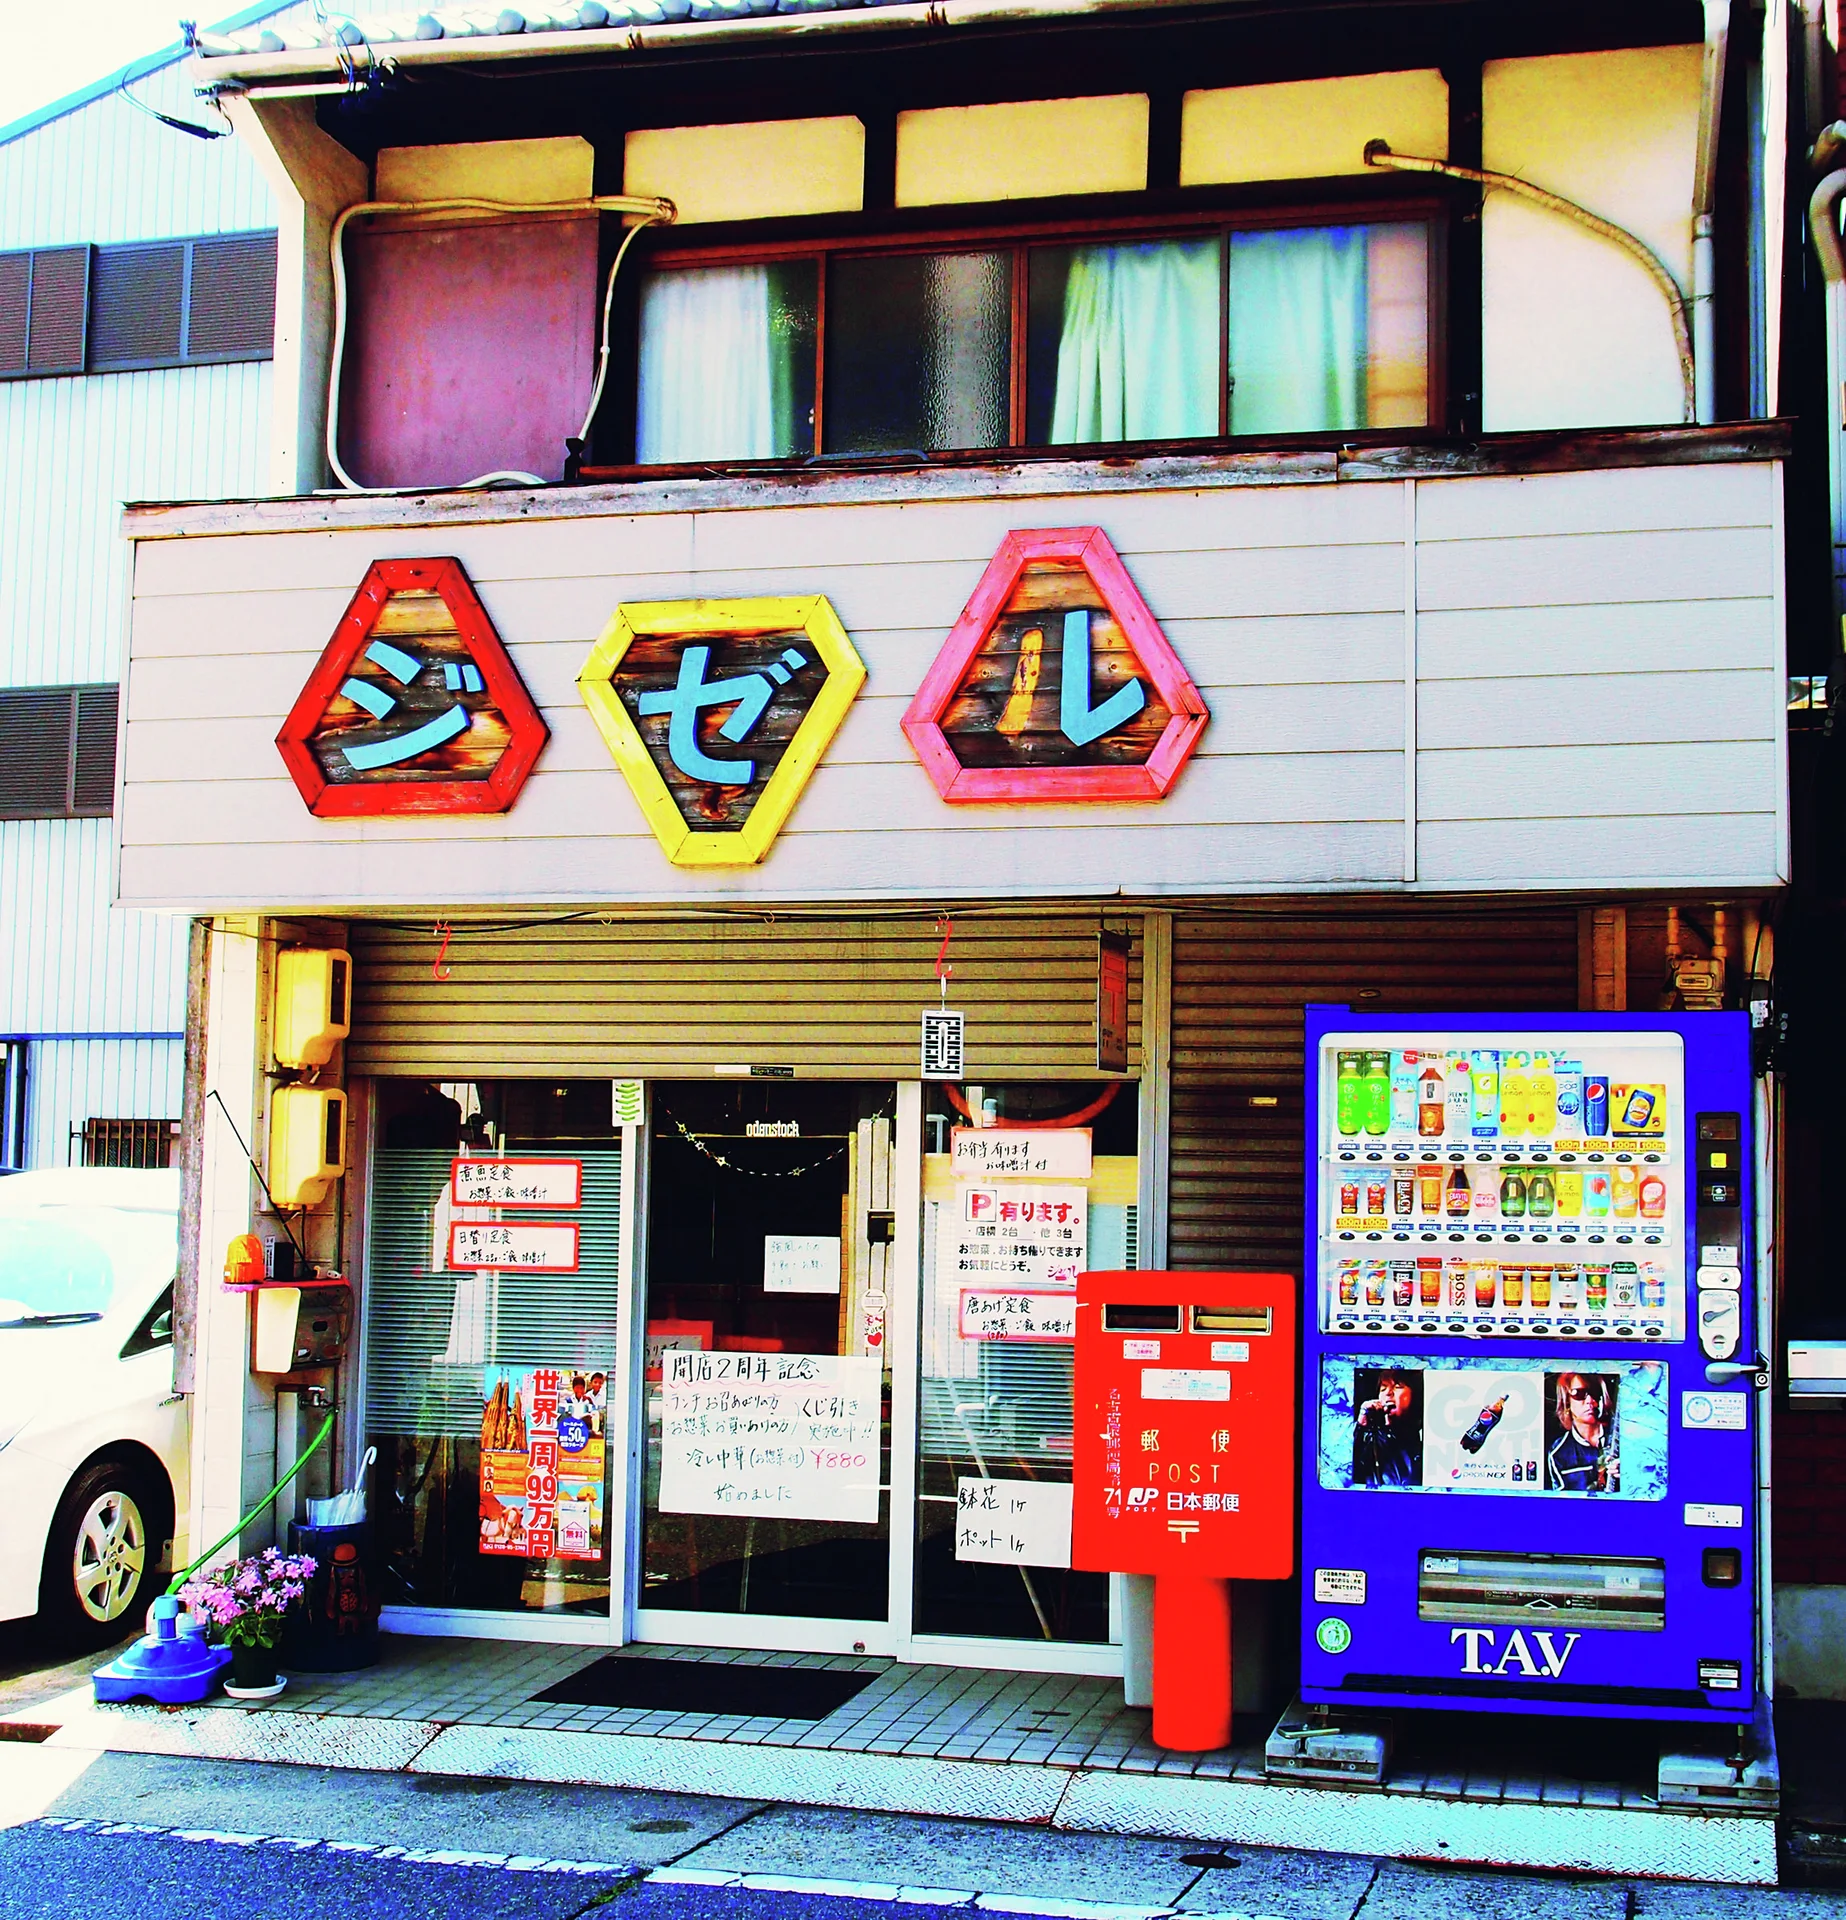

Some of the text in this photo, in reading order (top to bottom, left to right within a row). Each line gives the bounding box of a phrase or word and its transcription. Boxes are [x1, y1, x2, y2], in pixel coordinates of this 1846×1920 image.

[1400, 1182, 1411, 1213] BLACK
[1000, 1202, 1080, 1224] 有ります。
[1455, 1273, 1465, 1306] BOSS
[802, 1398, 859, 1418] くじ引き
[810, 1448, 867, 1470] ¥880
[1150, 1463, 1220, 1483] POST
[1486, 1471, 1507, 1479] NEX
[1104, 1488, 1121, 1505] 71
[1167, 1492, 1240, 1512] 日本郵便
[960, 1528, 1002, 1548] ポット
